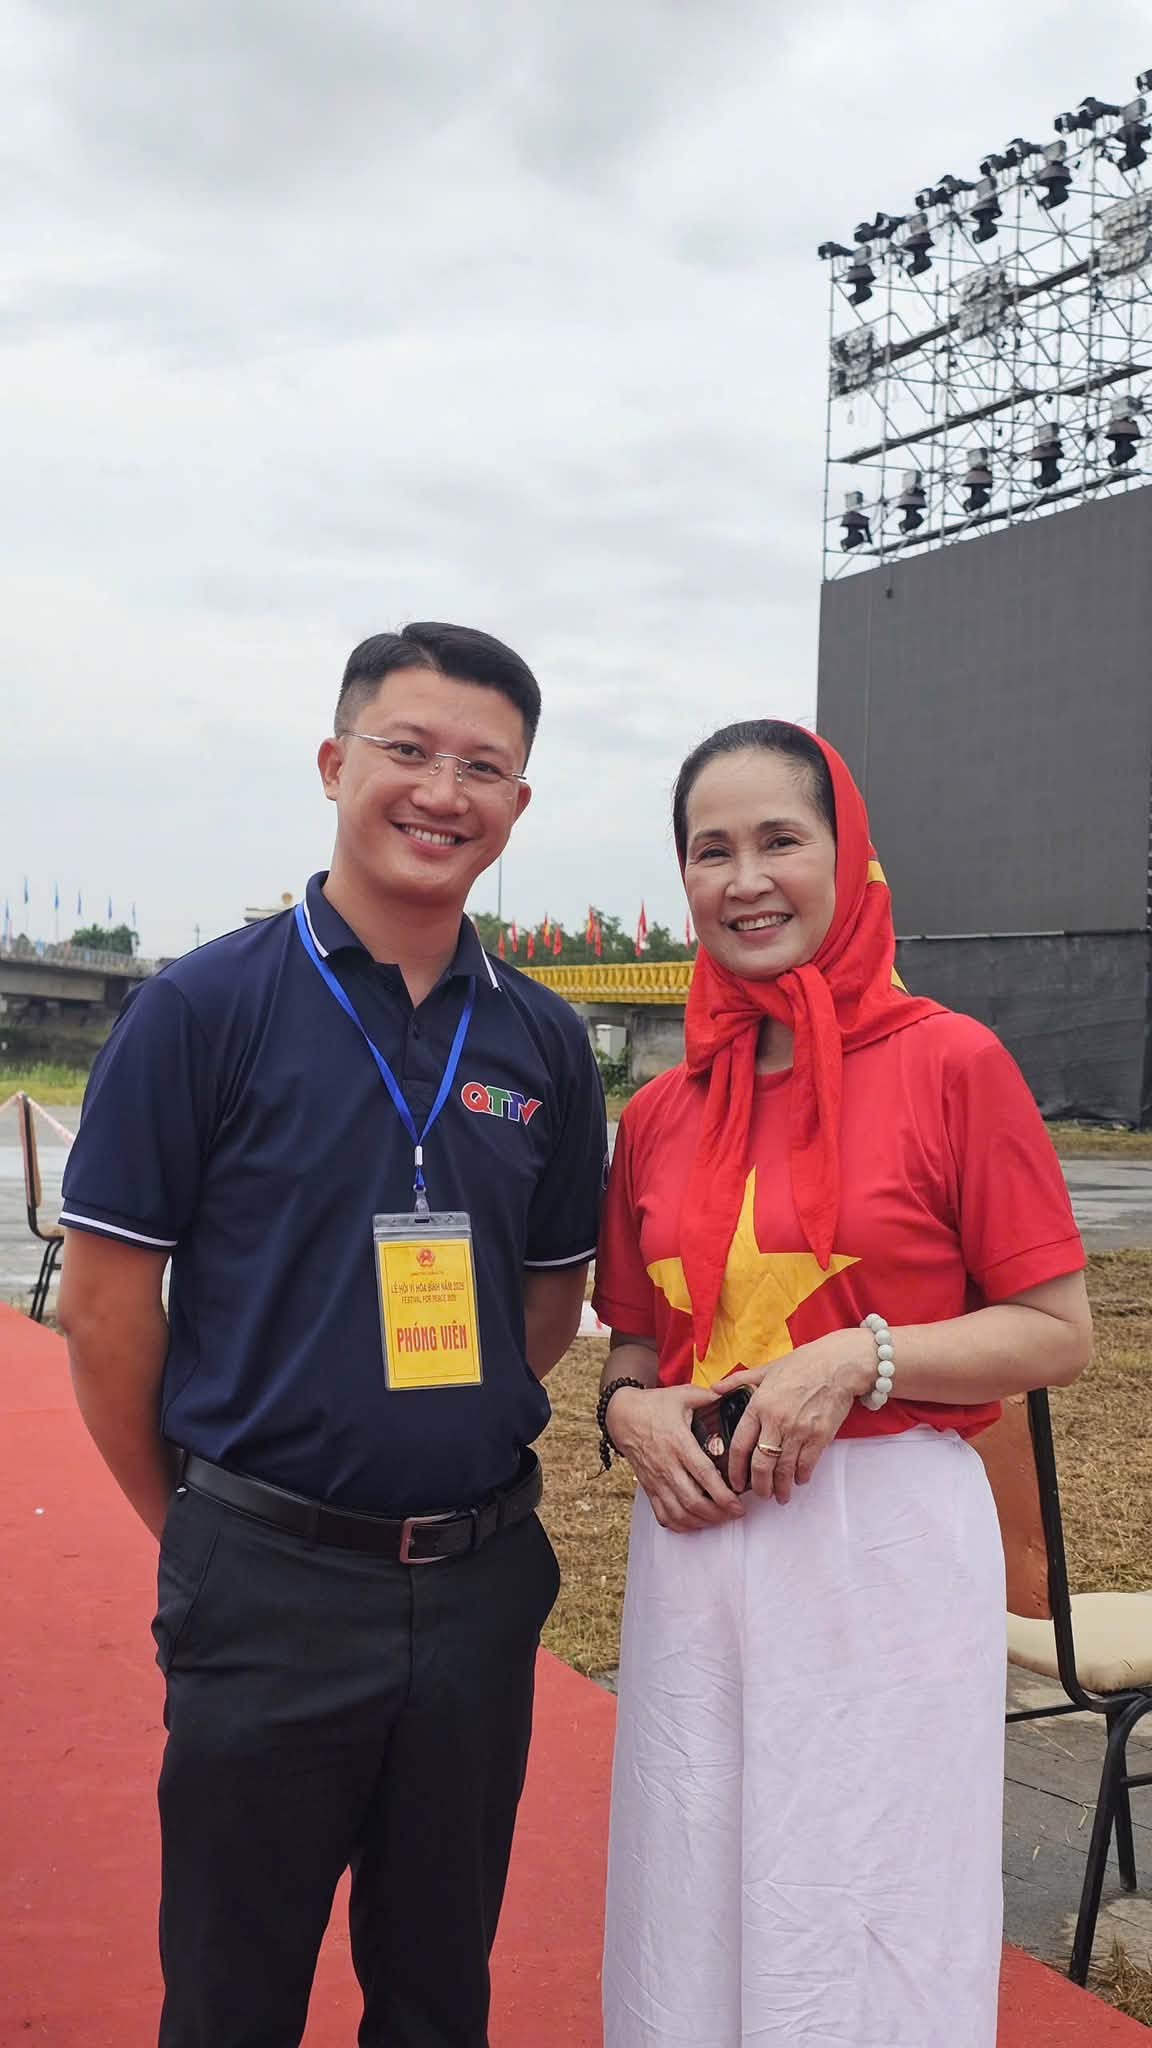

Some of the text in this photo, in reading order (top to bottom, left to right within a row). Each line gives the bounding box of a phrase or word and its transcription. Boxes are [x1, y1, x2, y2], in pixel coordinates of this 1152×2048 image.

[461, 1082, 543, 1125] QTTV
[396, 1319, 468, 1353] PHÓNG VIÊN
